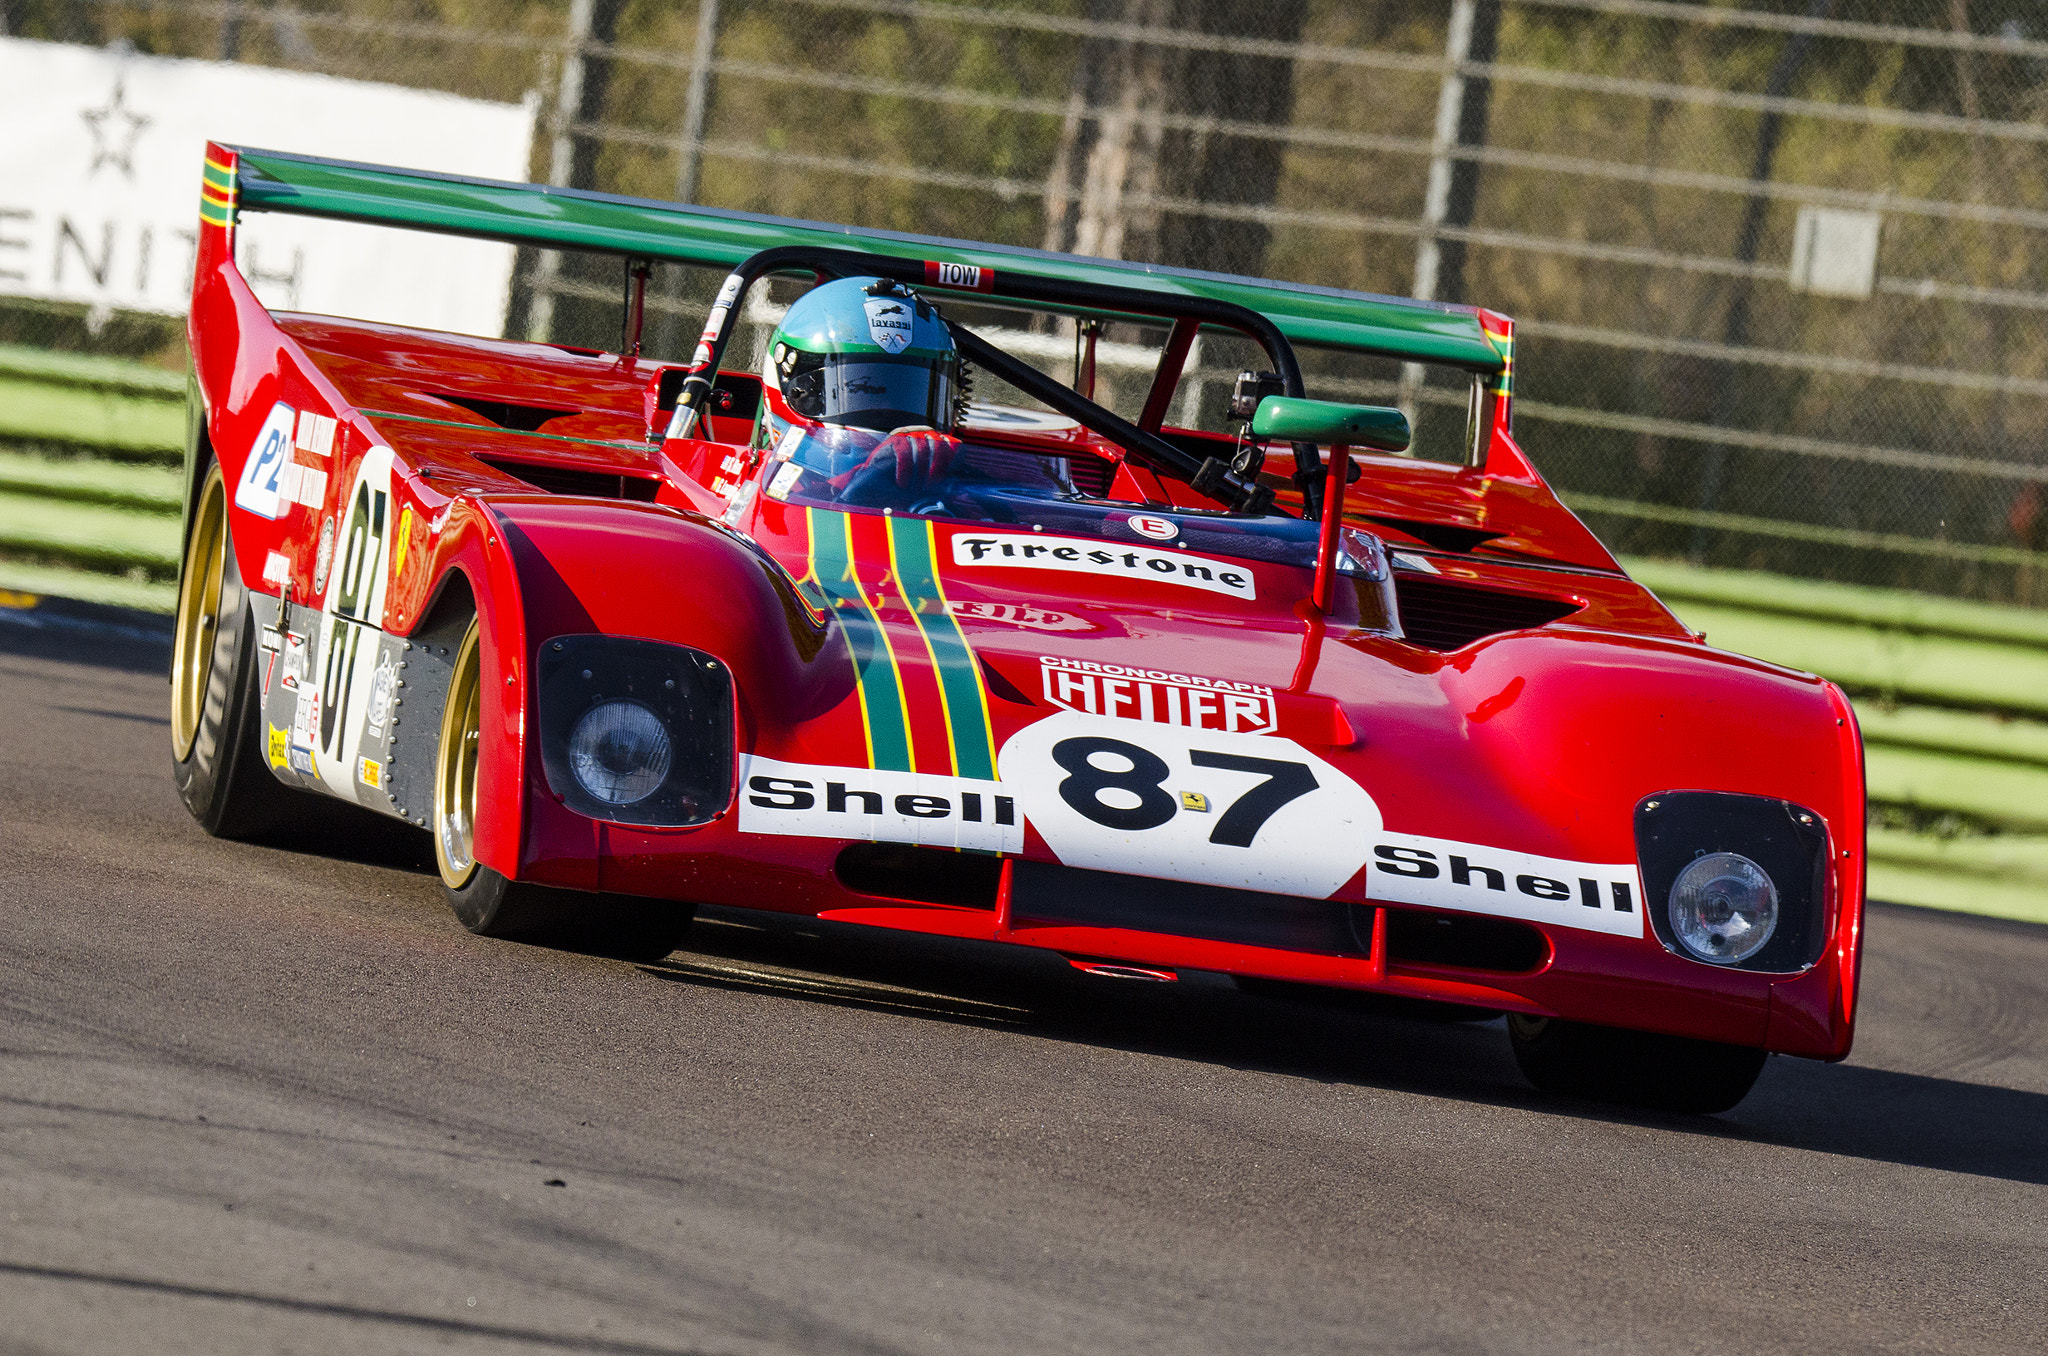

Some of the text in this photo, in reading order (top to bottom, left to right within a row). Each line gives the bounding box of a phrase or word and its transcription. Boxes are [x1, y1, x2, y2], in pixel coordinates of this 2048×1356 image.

[941, 263, 979, 287] TOW
[249, 428, 288, 493] P2
[1141, 519, 1165, 534] E
[961, 538, 1248, 590] Firestone
[320, 479, 387, 764] 87
[1039, 656, 1274, 696] CHRONOGRAPH
[747, 775, 1015, 827] Shell
[1051, 736, 1321, 848] 87
[1373, 844, 1635, 914] Shell
